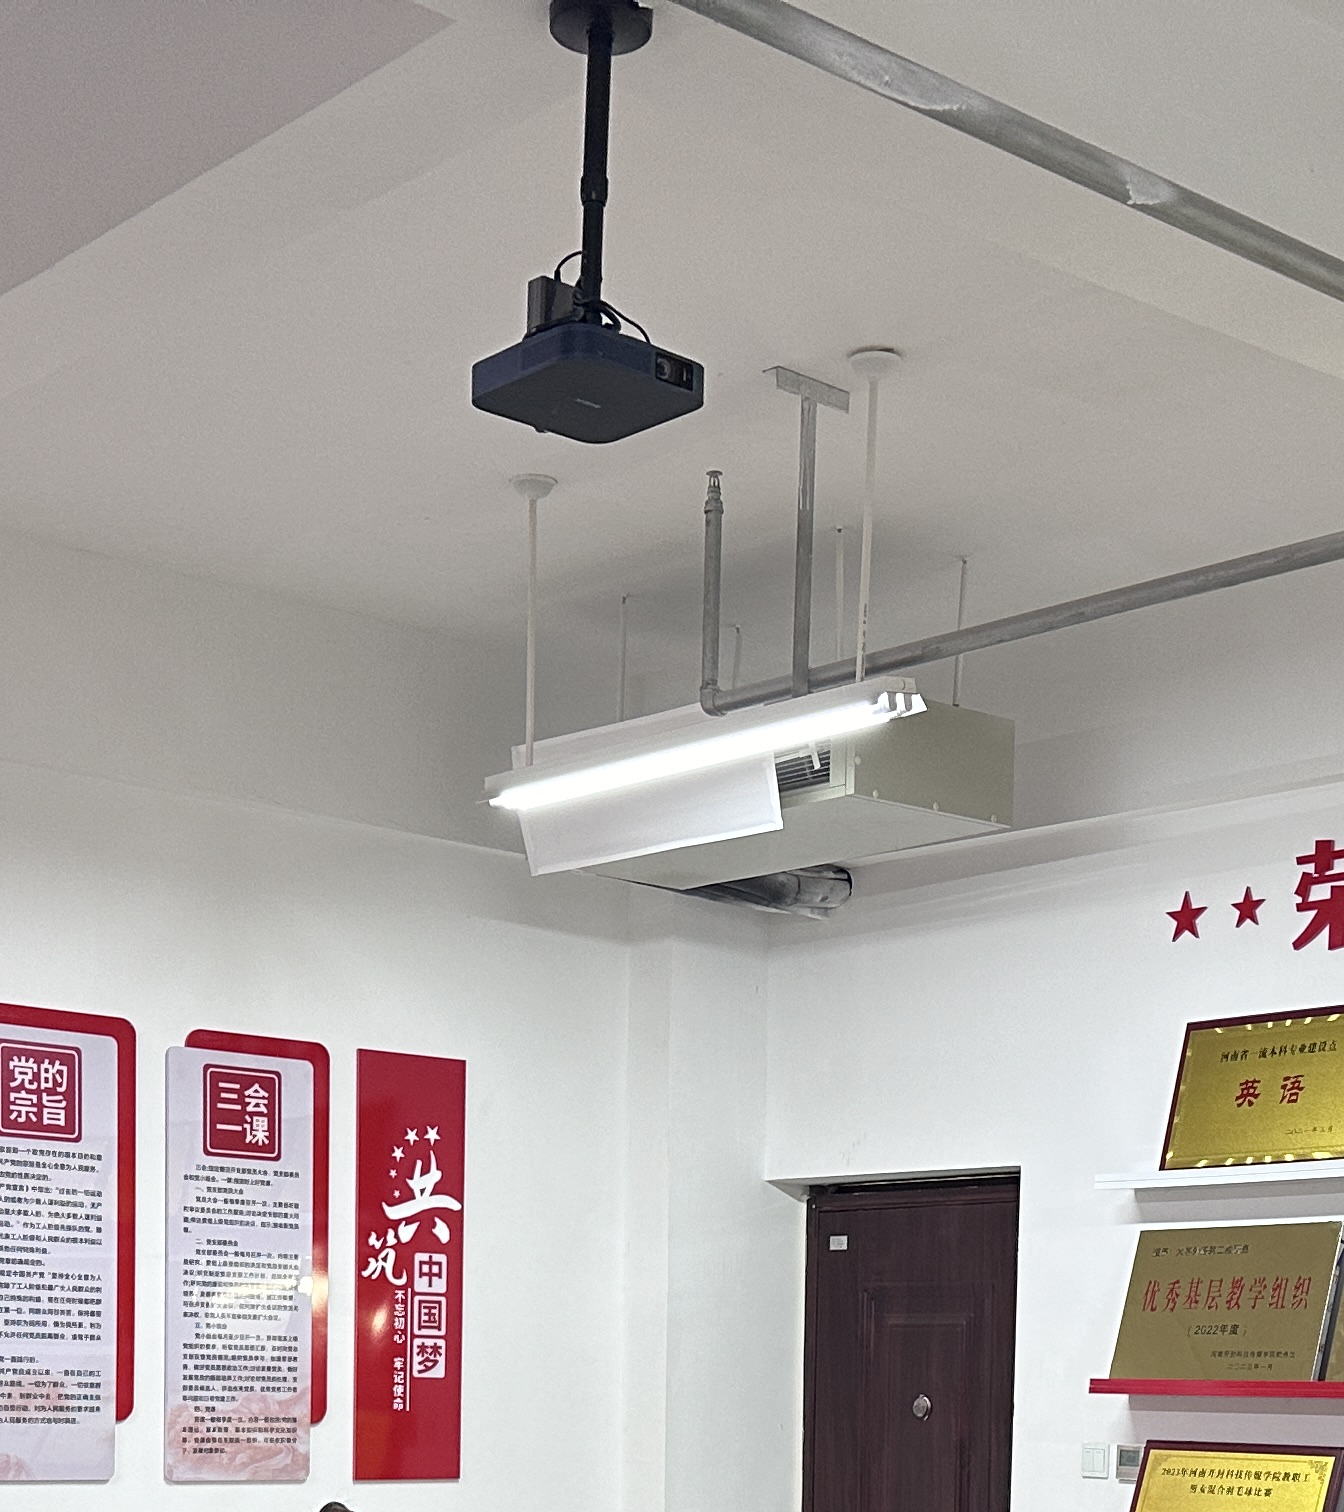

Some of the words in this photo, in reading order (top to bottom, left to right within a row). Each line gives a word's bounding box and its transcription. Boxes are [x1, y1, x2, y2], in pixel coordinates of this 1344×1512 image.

[9, 1056, 68, 1092] 党的
[1234, 1075, 1306, 1108] 英语
[9, 1089, 68, 1127] 宗旨
[216, 1081, 270, 1115] 三会
[216, 1114, 270, 1147] 一课
[1142, 1275, 1312, 1312] 优秀基层教学组织
[393, 1290, 406, 1344] 不忘初心
[416, 1254, 445, 1375] 中国梦
[393, 1357, 405, 1411] 牢记使命
